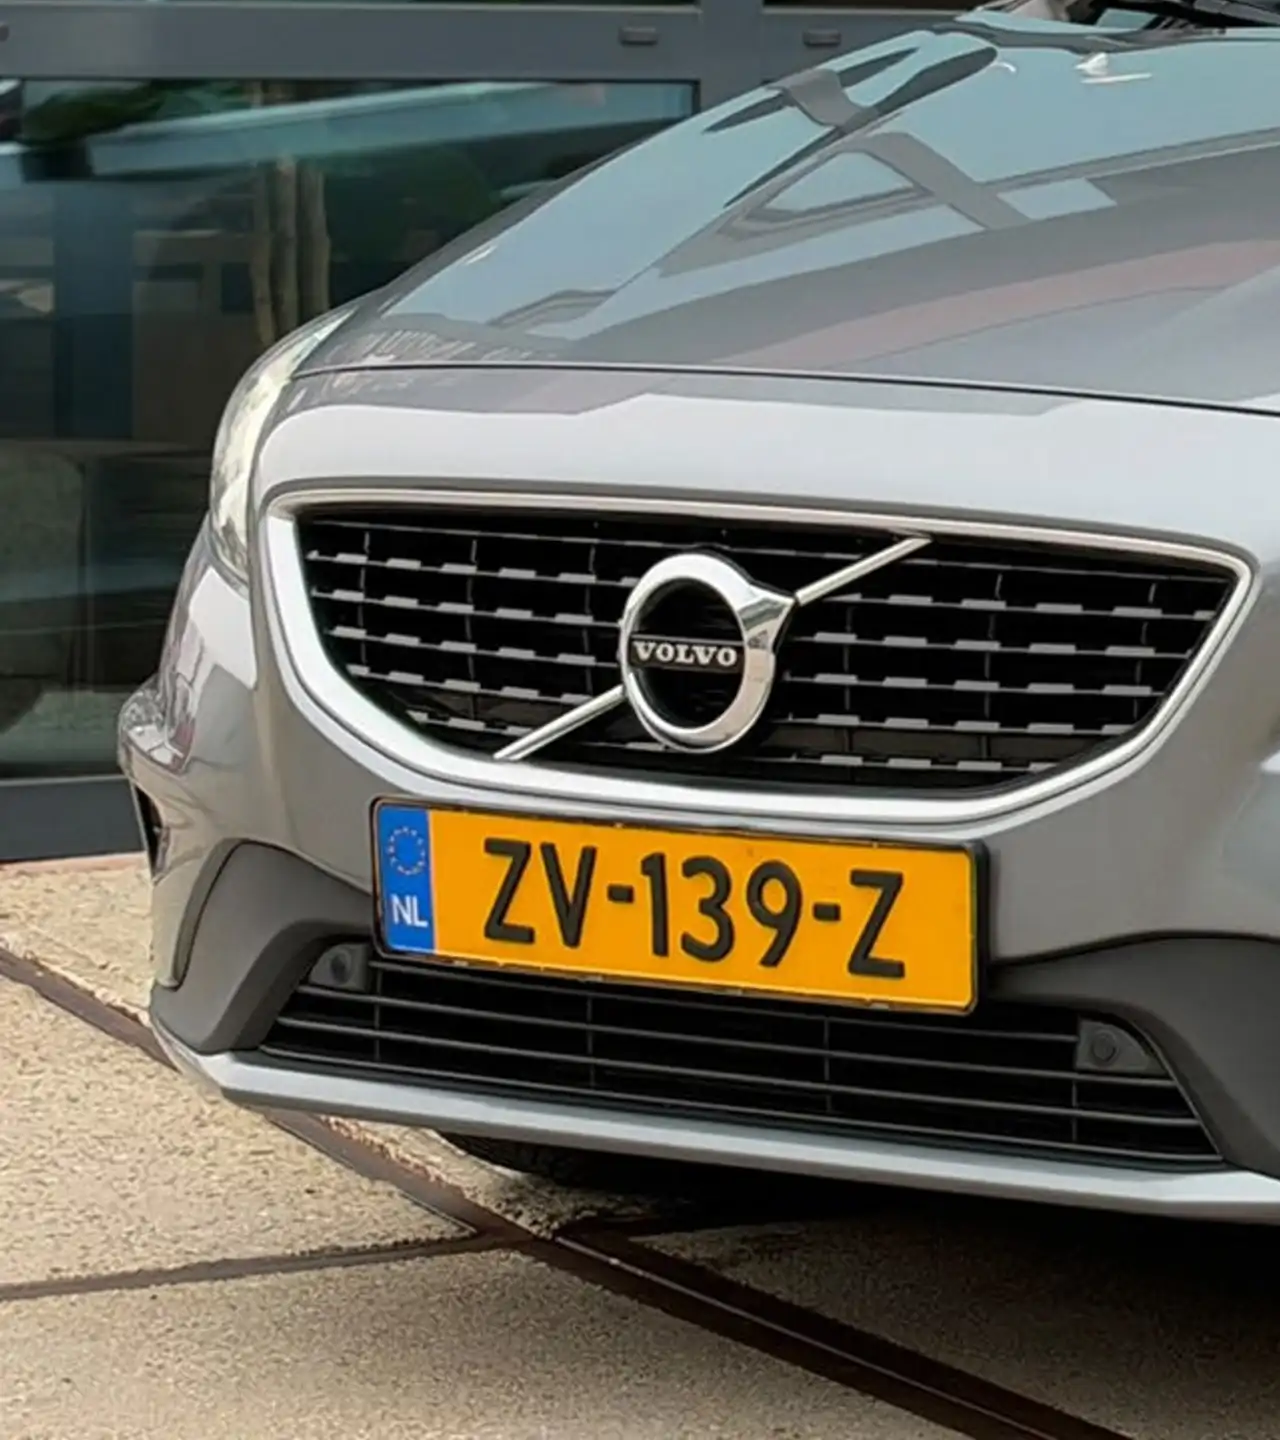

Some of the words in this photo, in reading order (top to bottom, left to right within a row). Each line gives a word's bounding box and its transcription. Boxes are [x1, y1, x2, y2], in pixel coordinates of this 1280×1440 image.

[632, 640, 738, 667] VOLVO
[391, 894, 429, 928] NL
[483, 837, 906, 979] ZV-139-Z
